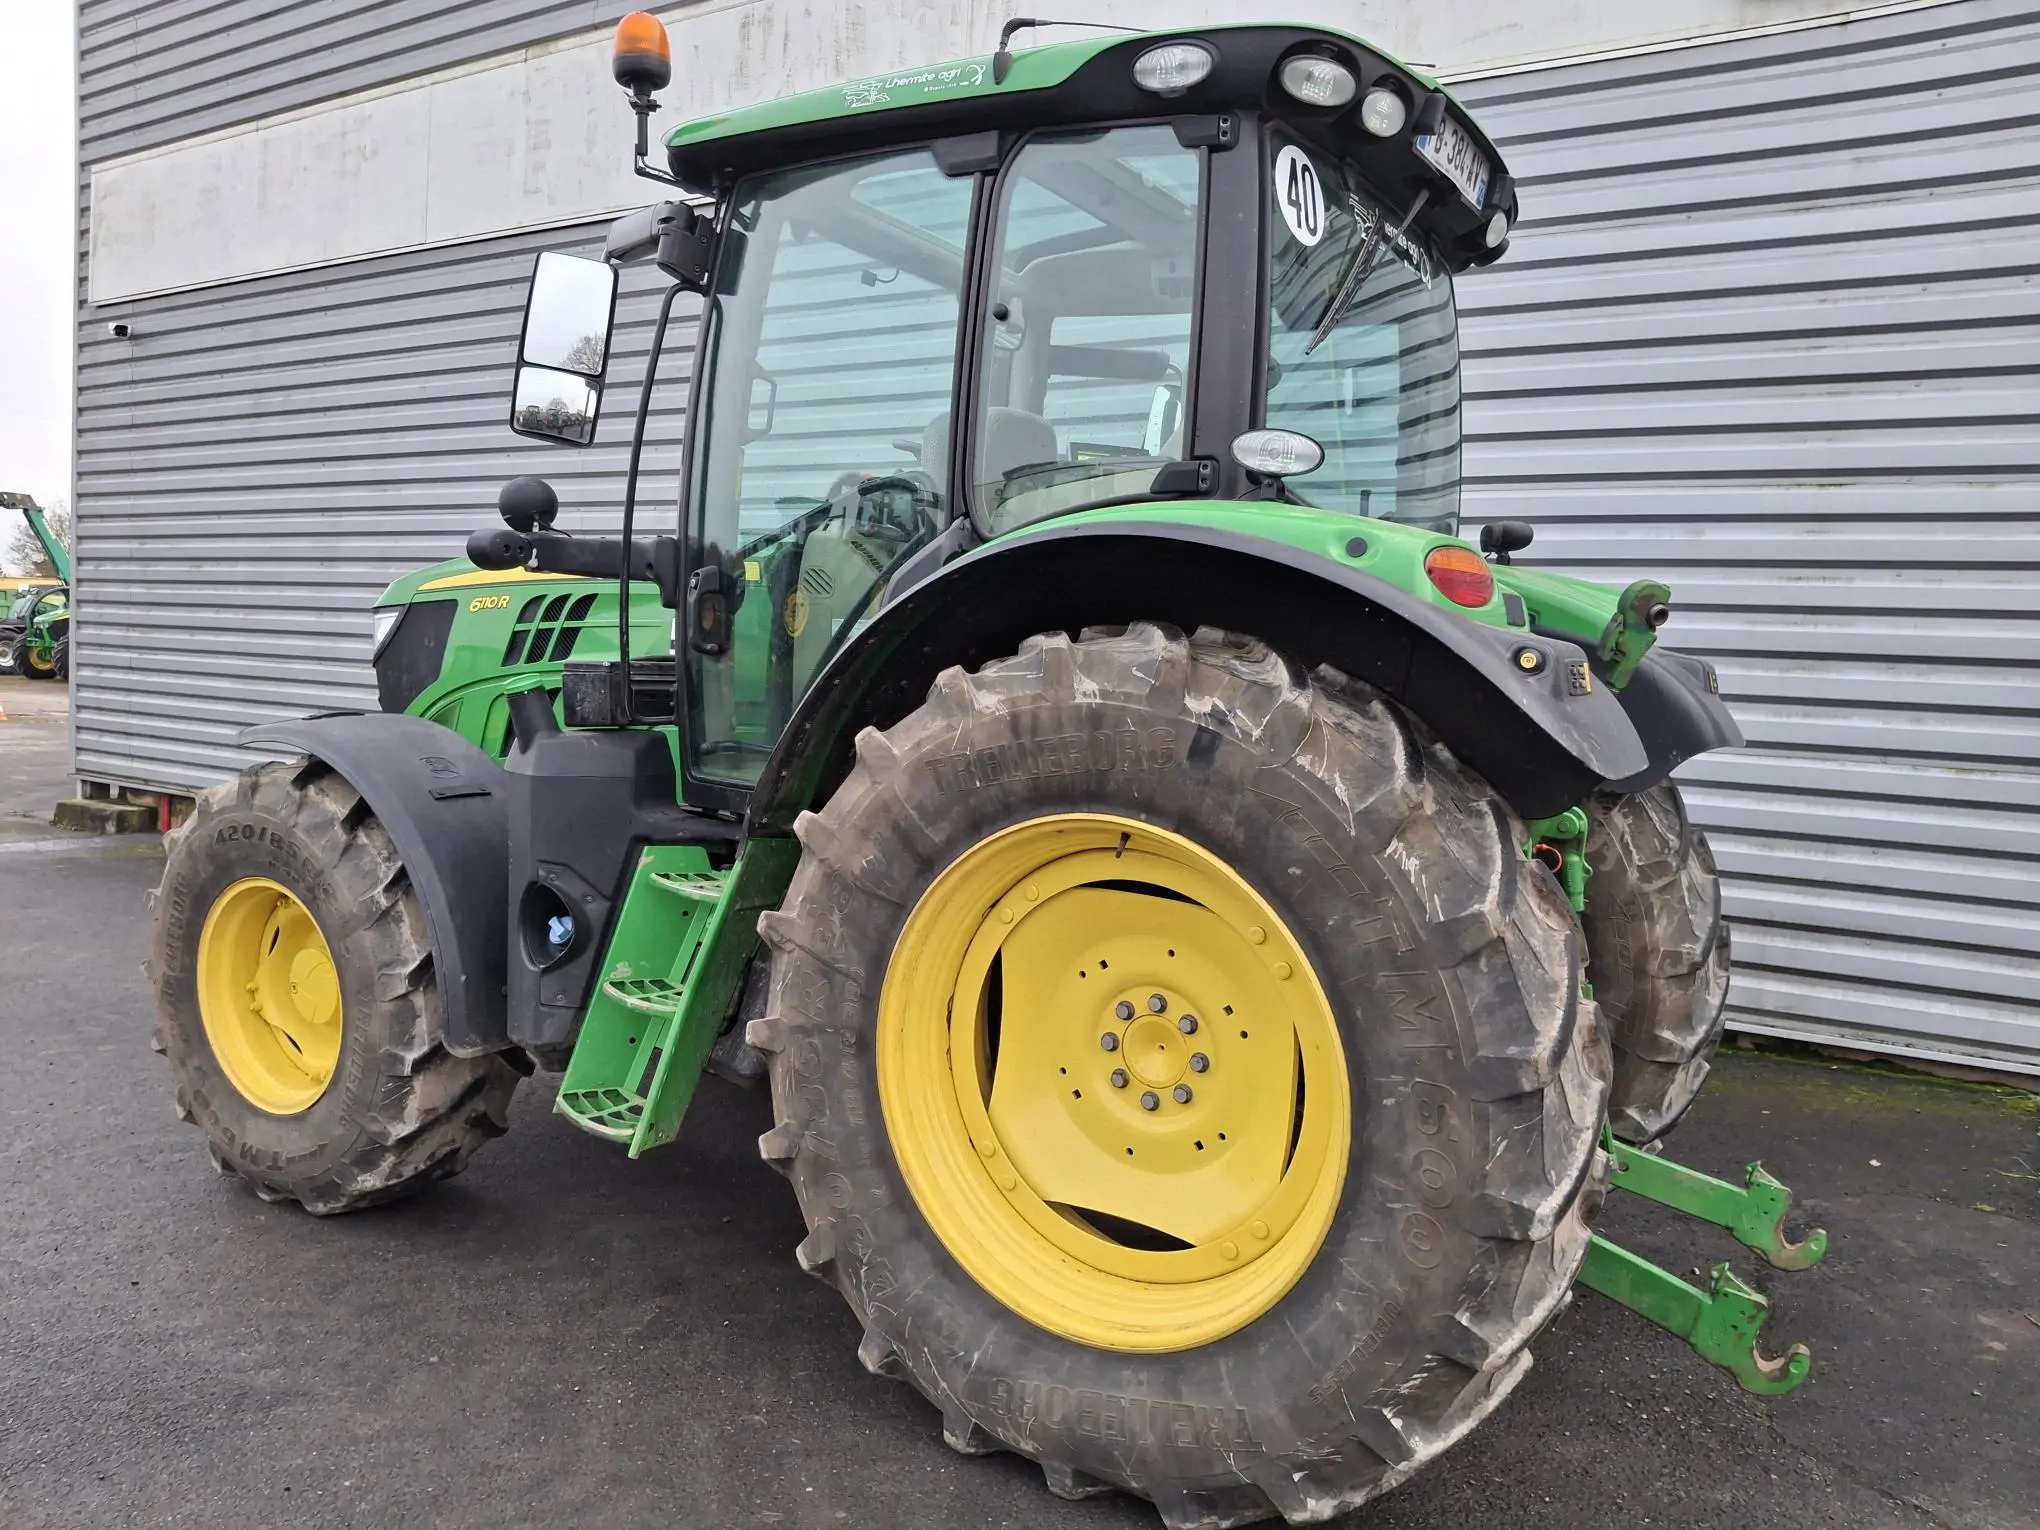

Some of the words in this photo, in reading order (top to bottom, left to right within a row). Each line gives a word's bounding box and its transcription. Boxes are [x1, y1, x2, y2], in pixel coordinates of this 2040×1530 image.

[885, 72, 936, 89] Lhermite
[938, 67, 962, 82] agri
[1427, 115, 1483, 193] B-384-AV
[1287, 156, 1318, 238] 40
[469, 595, 510, 612] 6110R
[924, 726, 1179, 797] TRELLEBORG
[214, 823, 301, 860] 420/85
[1308, 1285, 1409, 1406] TUBELESS
[990, 1376, 1264, 1453] TRELLEBORG
